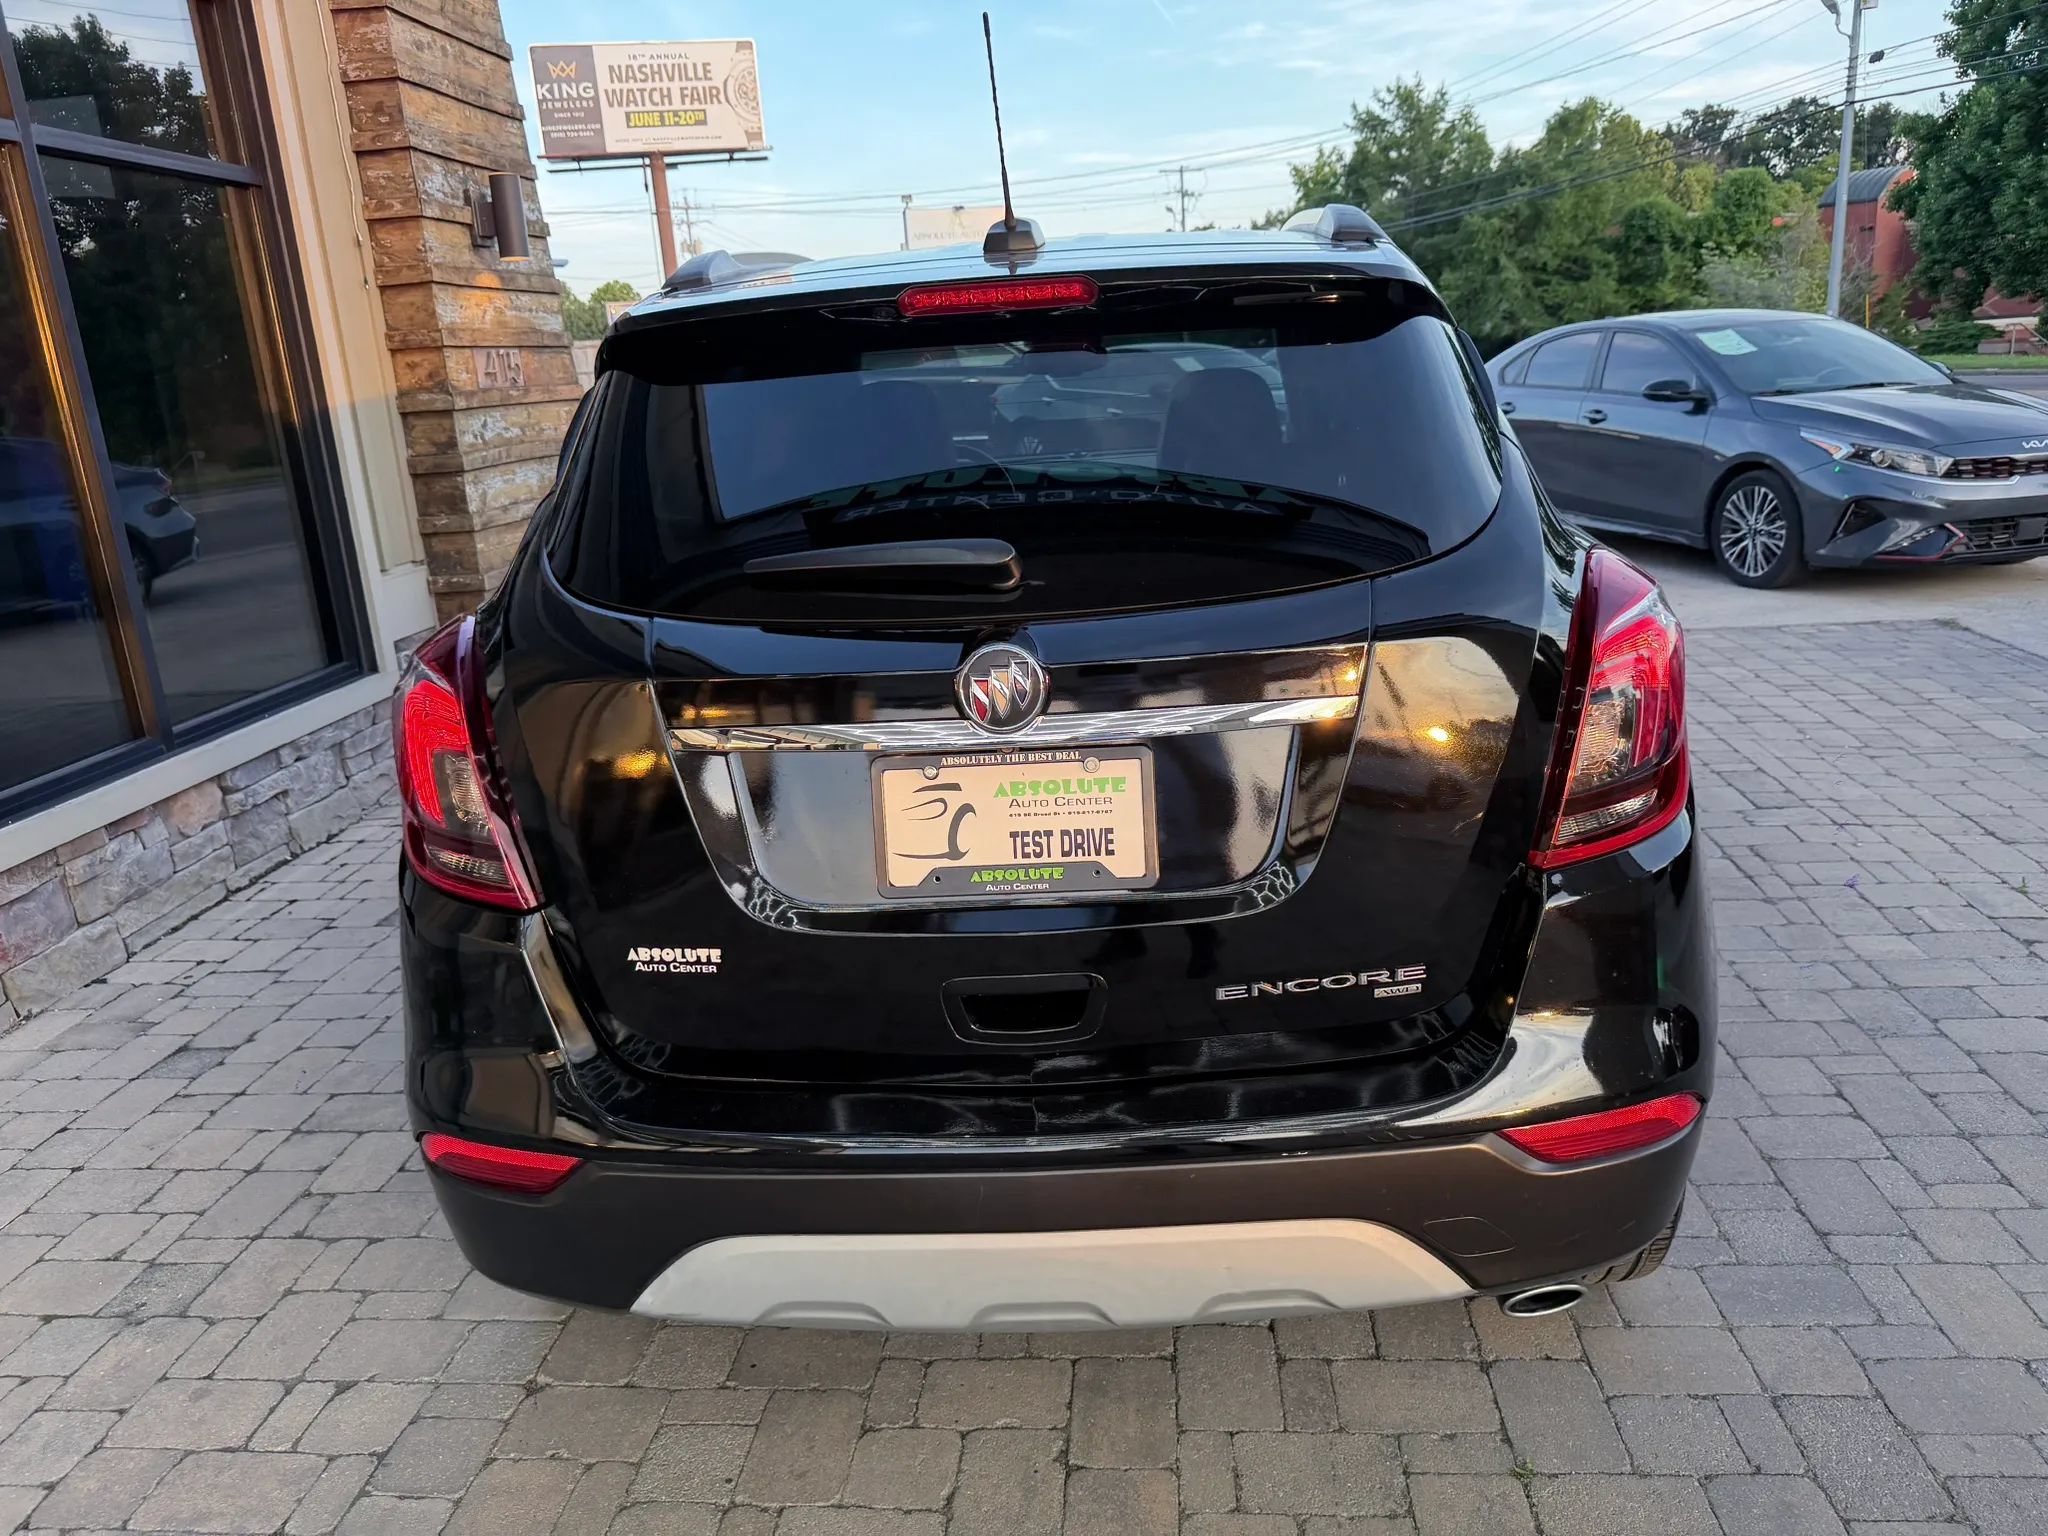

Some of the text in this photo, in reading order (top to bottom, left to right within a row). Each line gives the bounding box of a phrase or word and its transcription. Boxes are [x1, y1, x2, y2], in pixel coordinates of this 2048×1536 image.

[649, 52, 690, 60] ANNUAL
[608, 62, 712, 84] NASHVILLE
[536, 82, 595, 100] KING
[604, 85, 722, 108] WATCH FAIR
[542, 100, 594, 109] JEWELERS
[629, 112, 661, 127] JUNE
[484, 350, 522, 384] 415
[940, 751, 1082, 766] ABSOLUTELY THE BEST DEAL
[993, 776, 1127, 798] ABSOLUTE
[1009, 828, 1116, 859] TEST DRIVE
[970, 867, 1065, 883] ABSOLUTE
[627, 947, 722, 963] ABSOLUTE
[1215, 963, 1427, 1000] ENCORE
